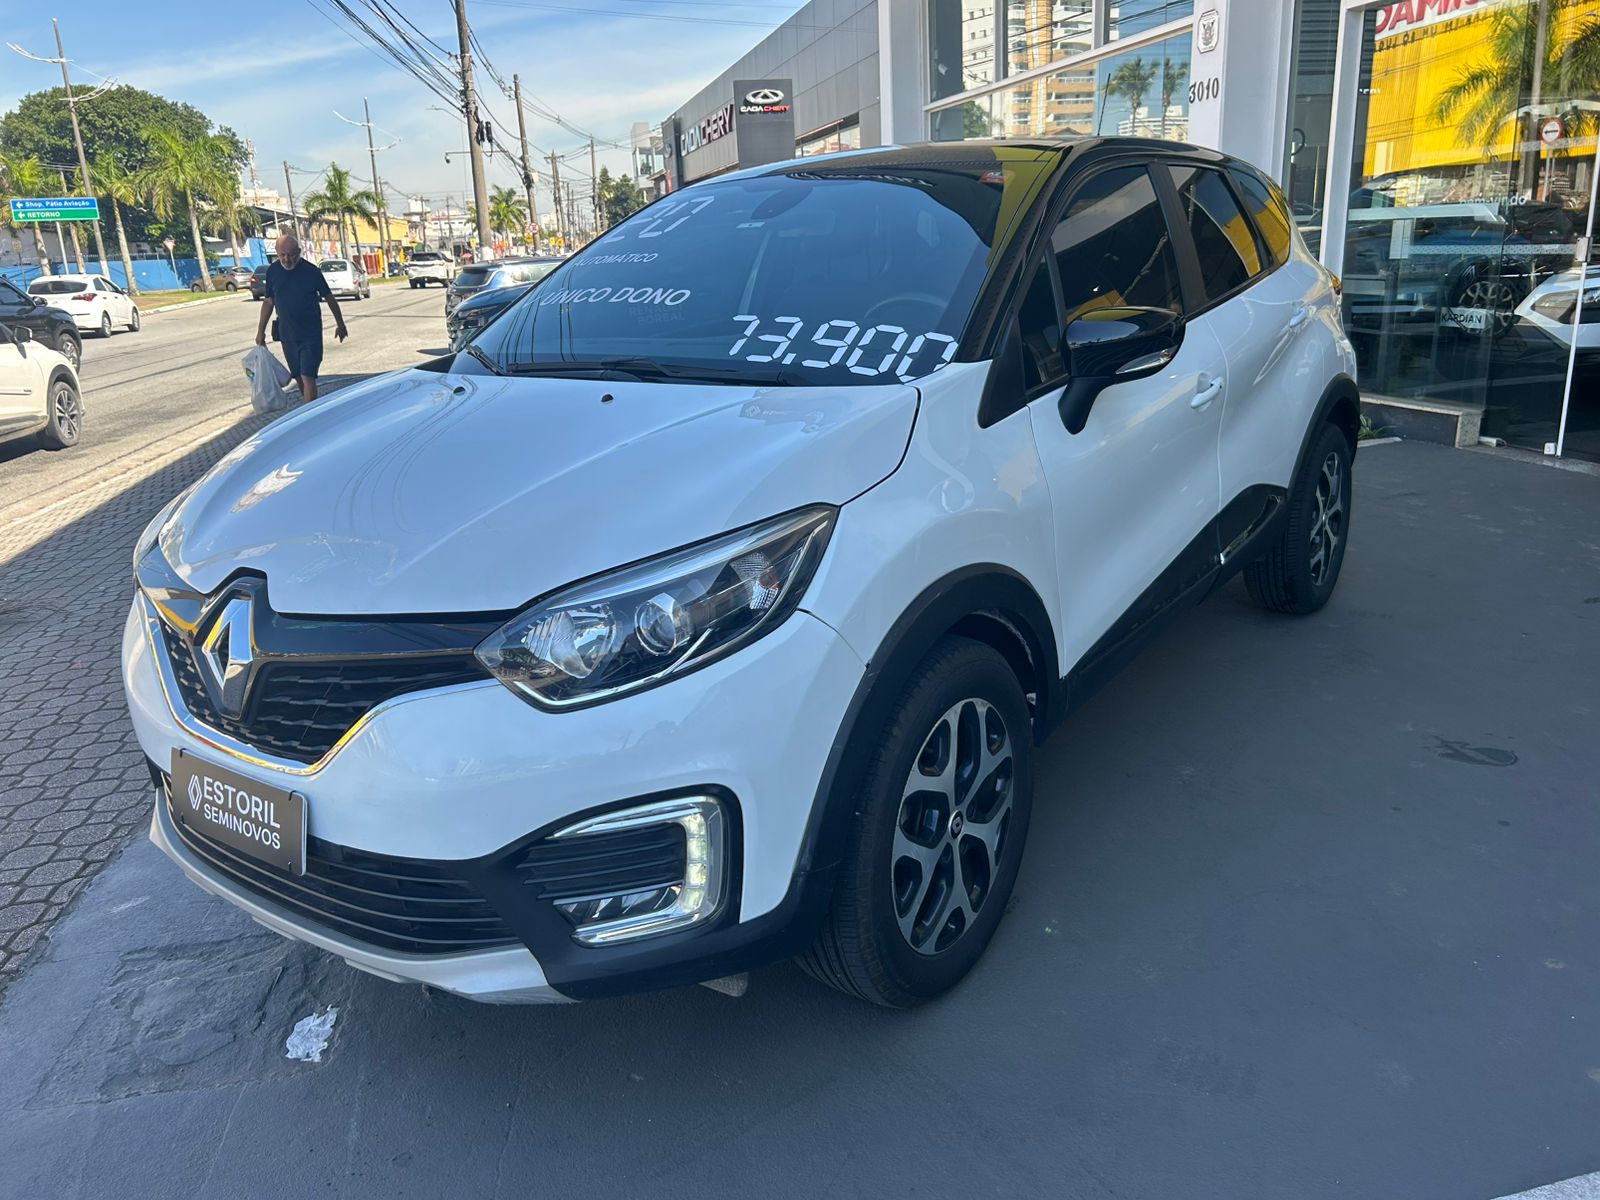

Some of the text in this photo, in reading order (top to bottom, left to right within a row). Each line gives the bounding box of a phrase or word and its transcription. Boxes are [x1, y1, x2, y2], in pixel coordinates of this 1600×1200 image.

[1188, 77, 1219, 103] 3010
[700, 103, 734, 148] CHERY
[764, 104, 791, 112] CHERY
[539, 287, 691, 306] ÚNICO DONO
[1440, 312, 1483, 324] KARDIAN
[728, 314, 959, 383] 73.900
[203, 775, 281, 829] ESTORIL
[203, 803, 281, 850] SEMINOVOS
